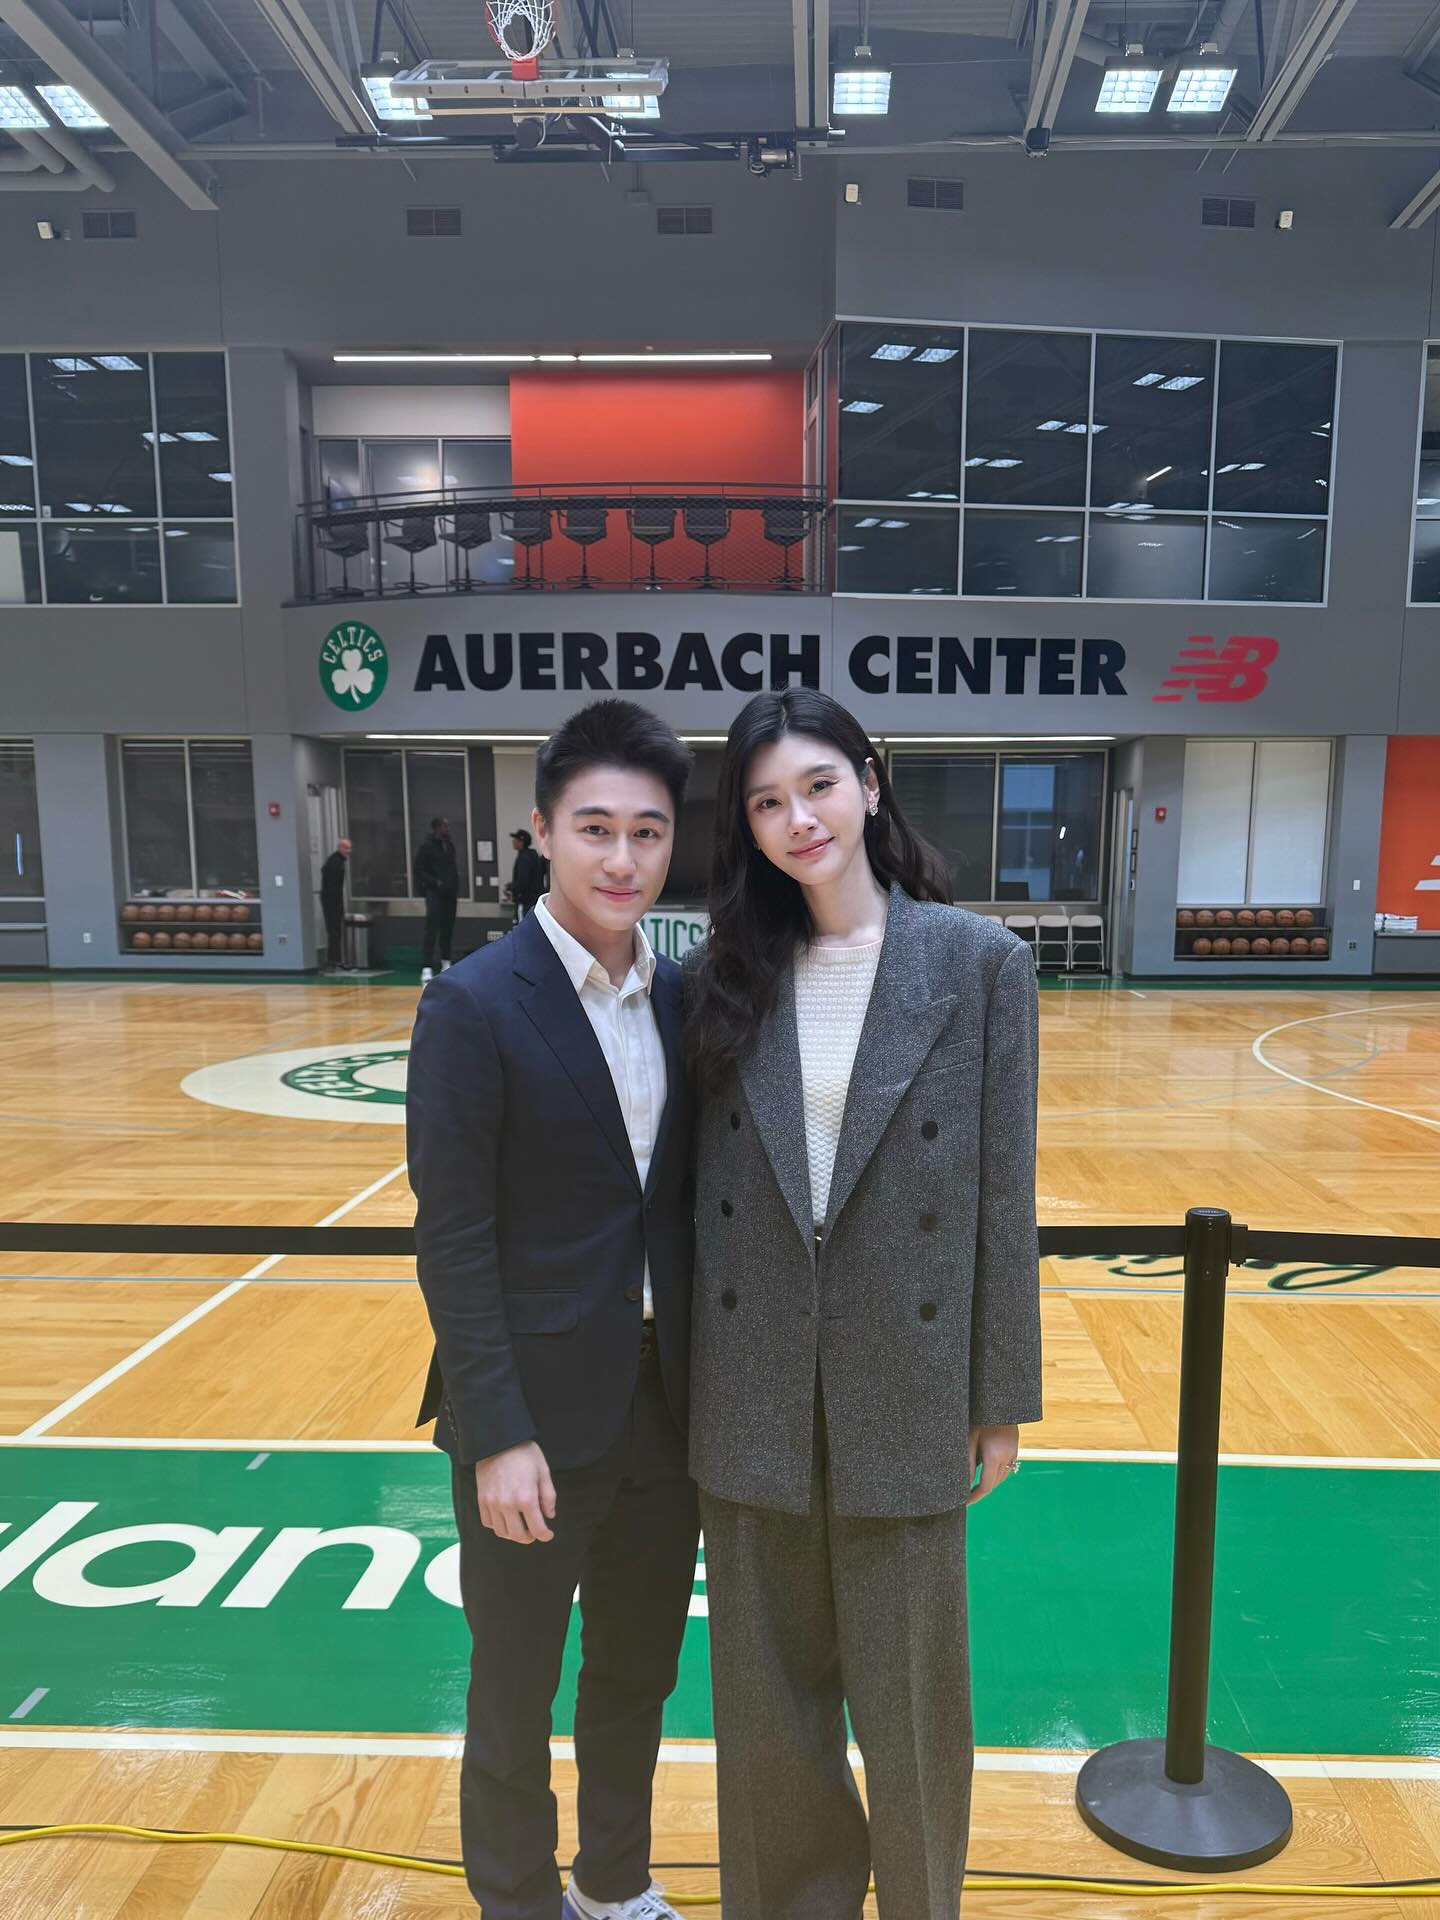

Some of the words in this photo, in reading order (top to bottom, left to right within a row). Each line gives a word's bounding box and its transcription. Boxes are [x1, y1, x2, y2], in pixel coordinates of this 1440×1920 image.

[322, 626, 383, 663] CELTICS
[414, 632, 820, 692] AUERBACH
[848, 635, 1128, 695] CENTER
